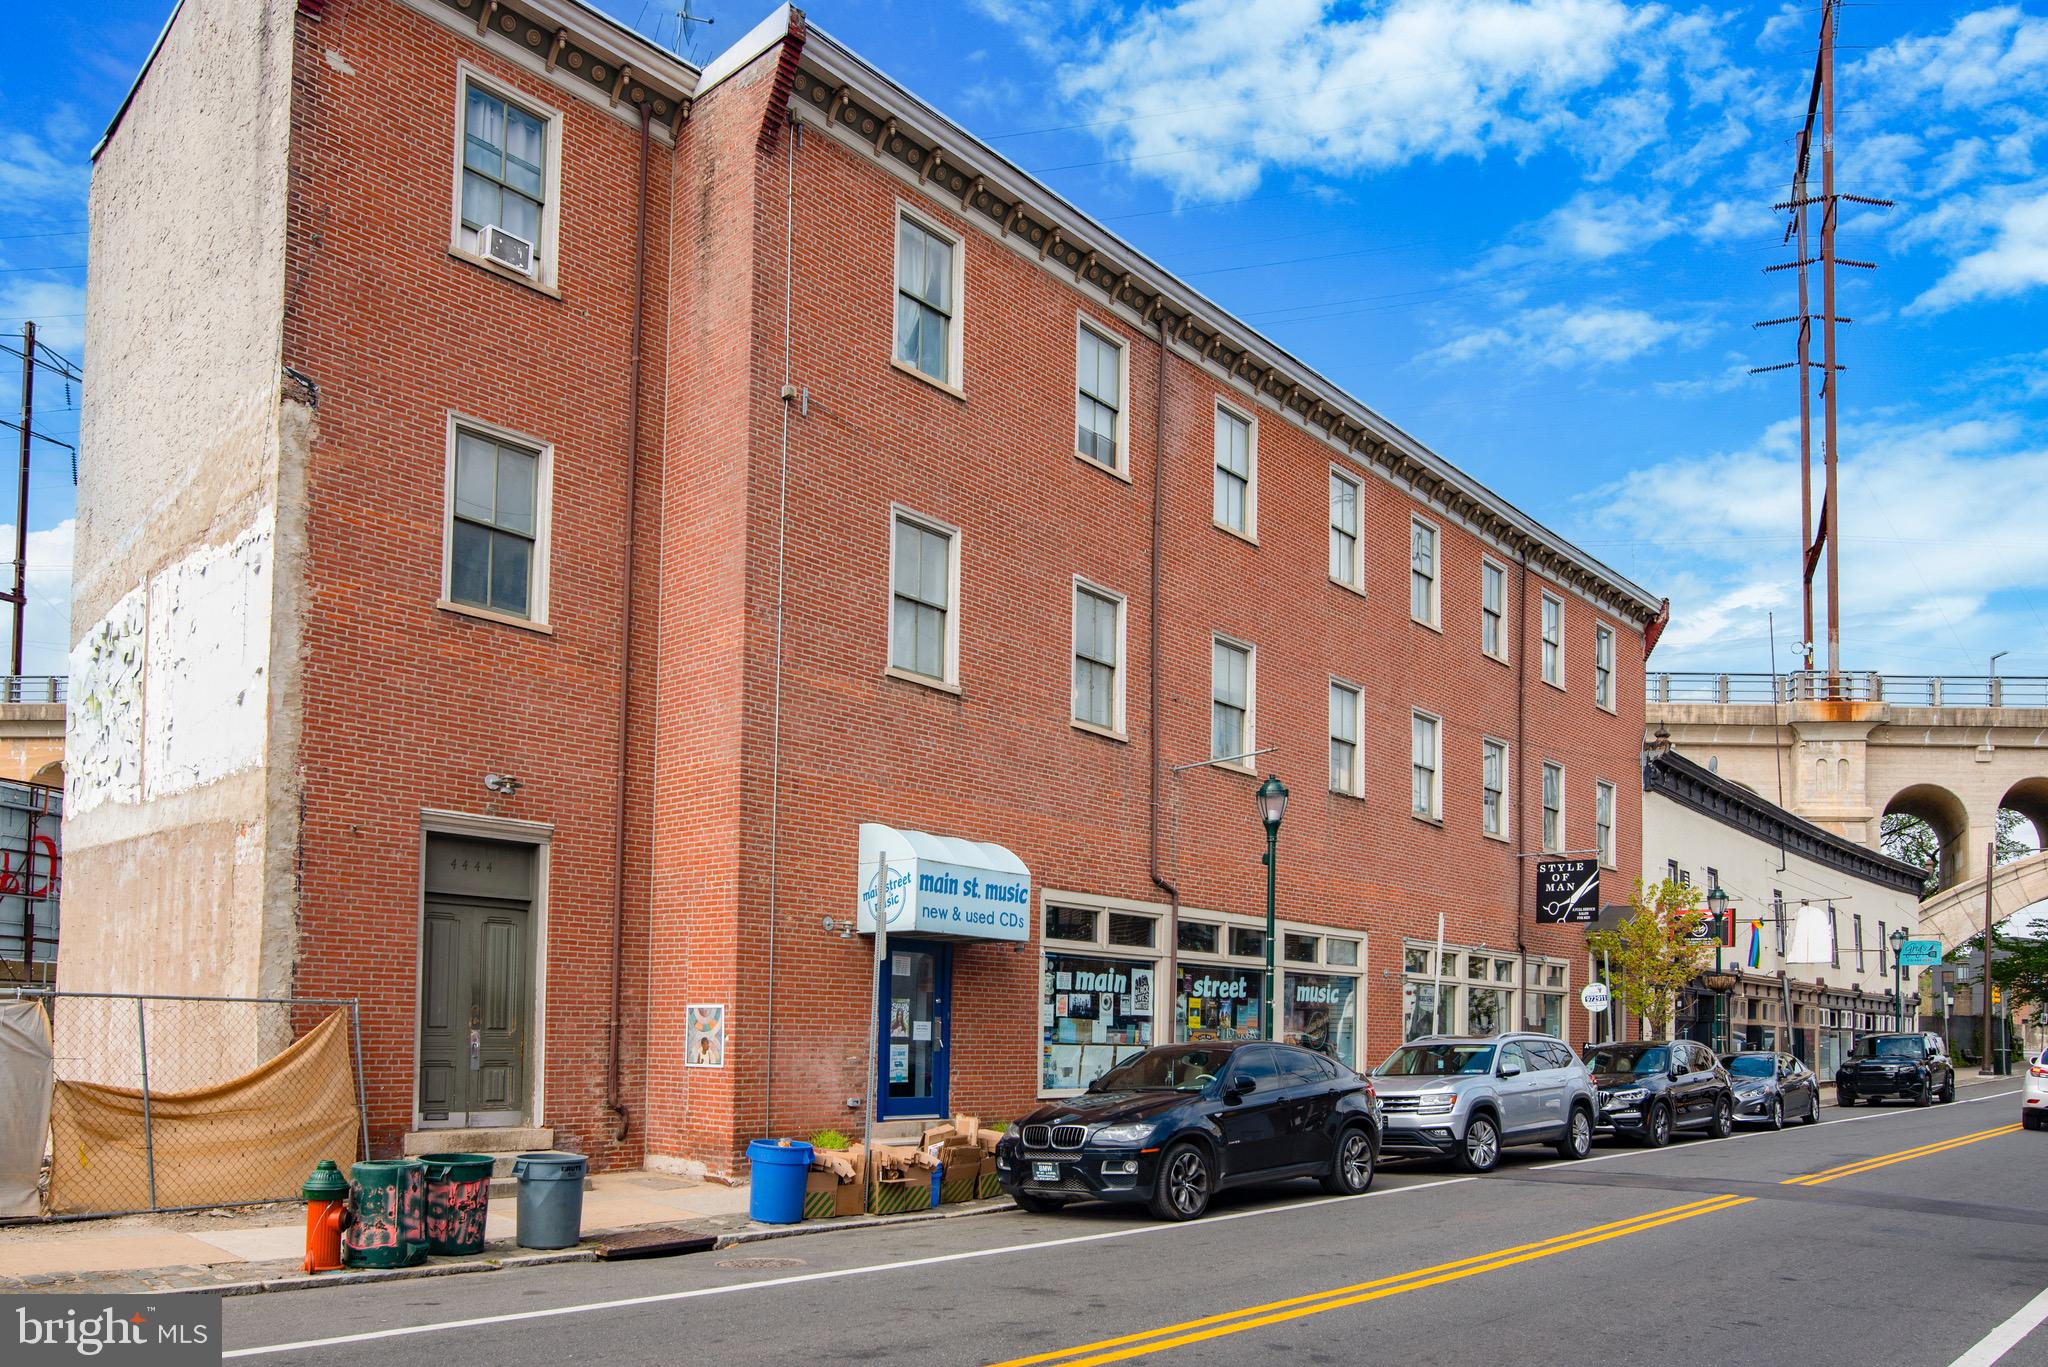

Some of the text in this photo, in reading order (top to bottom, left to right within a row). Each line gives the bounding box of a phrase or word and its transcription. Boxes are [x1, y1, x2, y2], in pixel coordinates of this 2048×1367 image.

[450, 858, 493, 872] 4444
[1540, 863, 1584, 872] STYLE
[1552, 873, 1570, 882] OF
[863, 885, 879, 901] mai
[919, 872, 1029, 904] main st. music
[1545, 883, 1575, 891] MAN
[922, 906, 1025, 928] new & used CDs
[1075, 967, 1127, 993] main
[1192, 975, 1247, 998] street
[1296, 983, 1340, 1004] music
